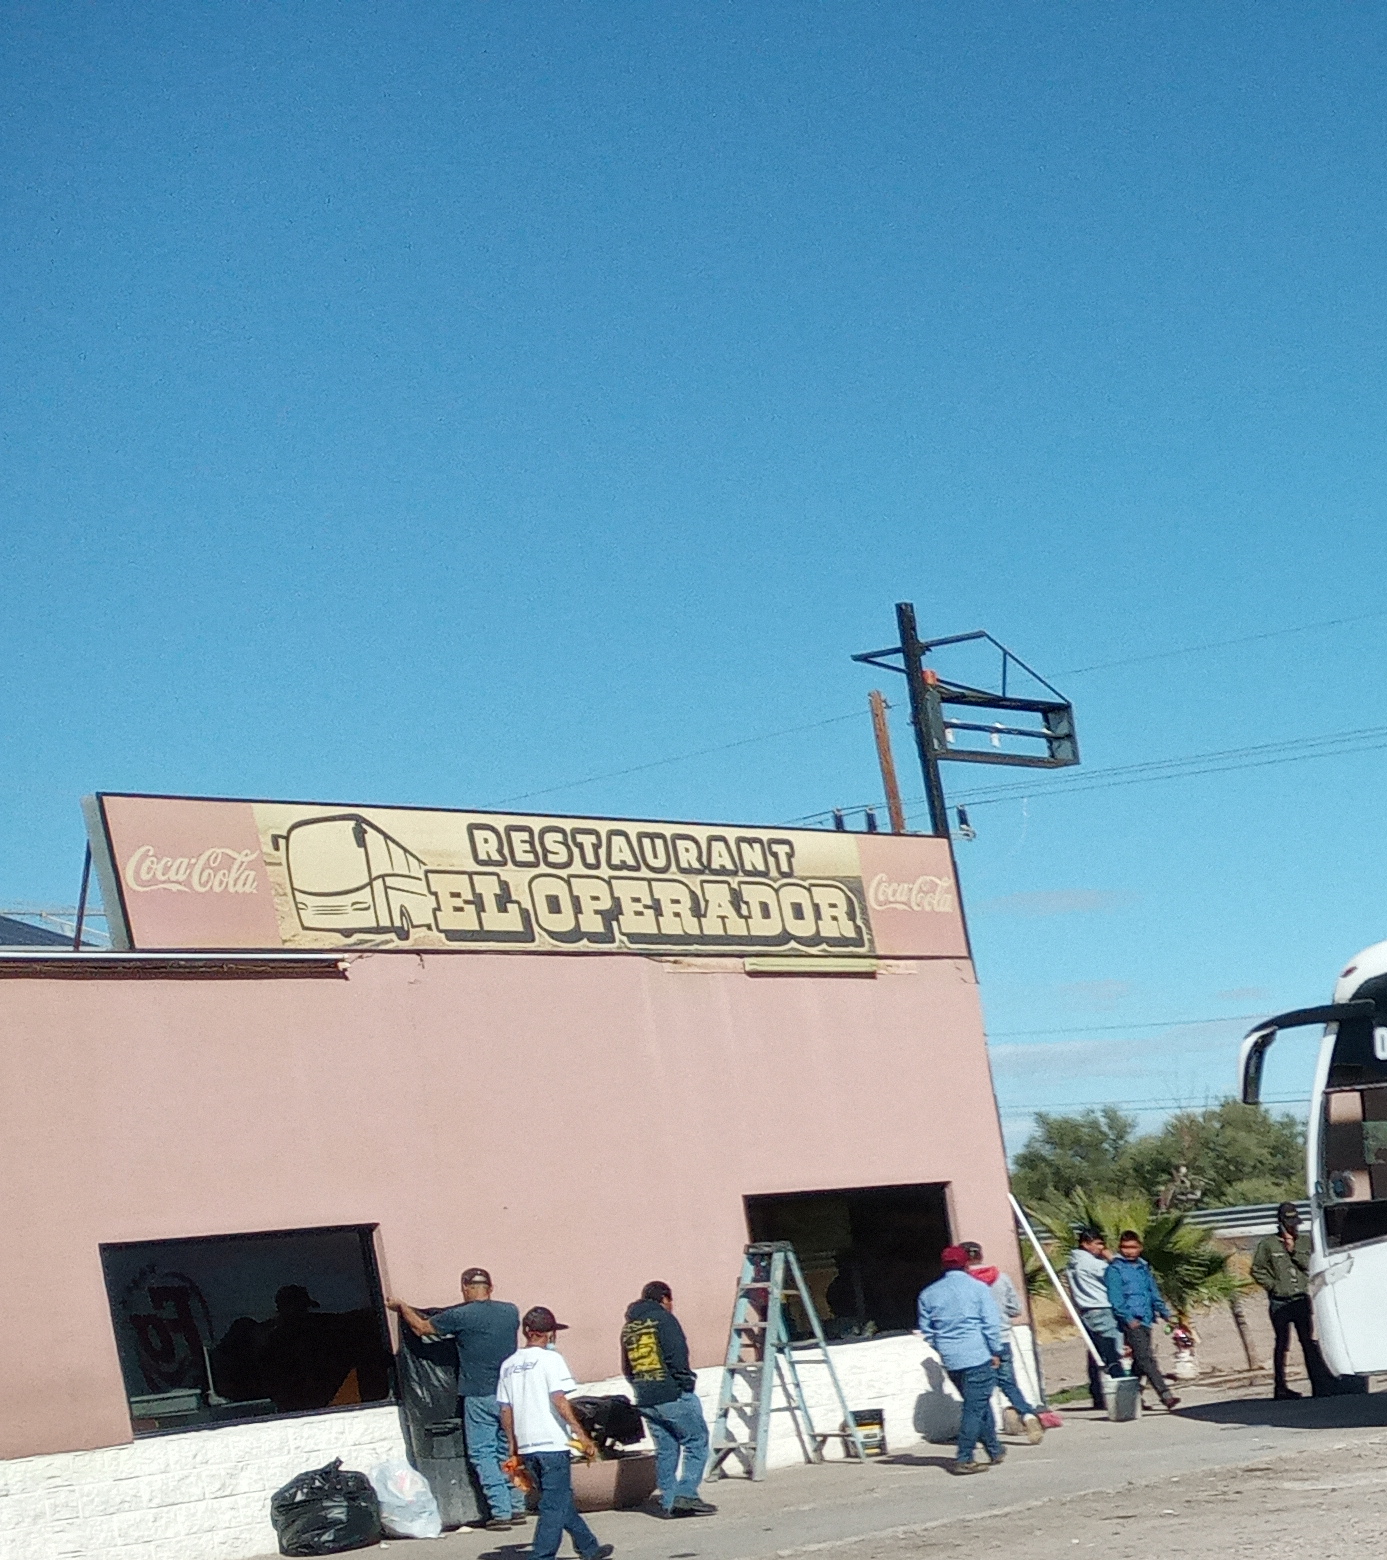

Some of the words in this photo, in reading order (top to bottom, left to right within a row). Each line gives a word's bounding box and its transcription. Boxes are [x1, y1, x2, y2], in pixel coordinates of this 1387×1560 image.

[125, 845, 260, 893] Coca-Cola
[467, 823, 795, 877] RESTAURANT
[424, 869, 535, 942] EL
[528, 873, 865, 947] OPERADOR
